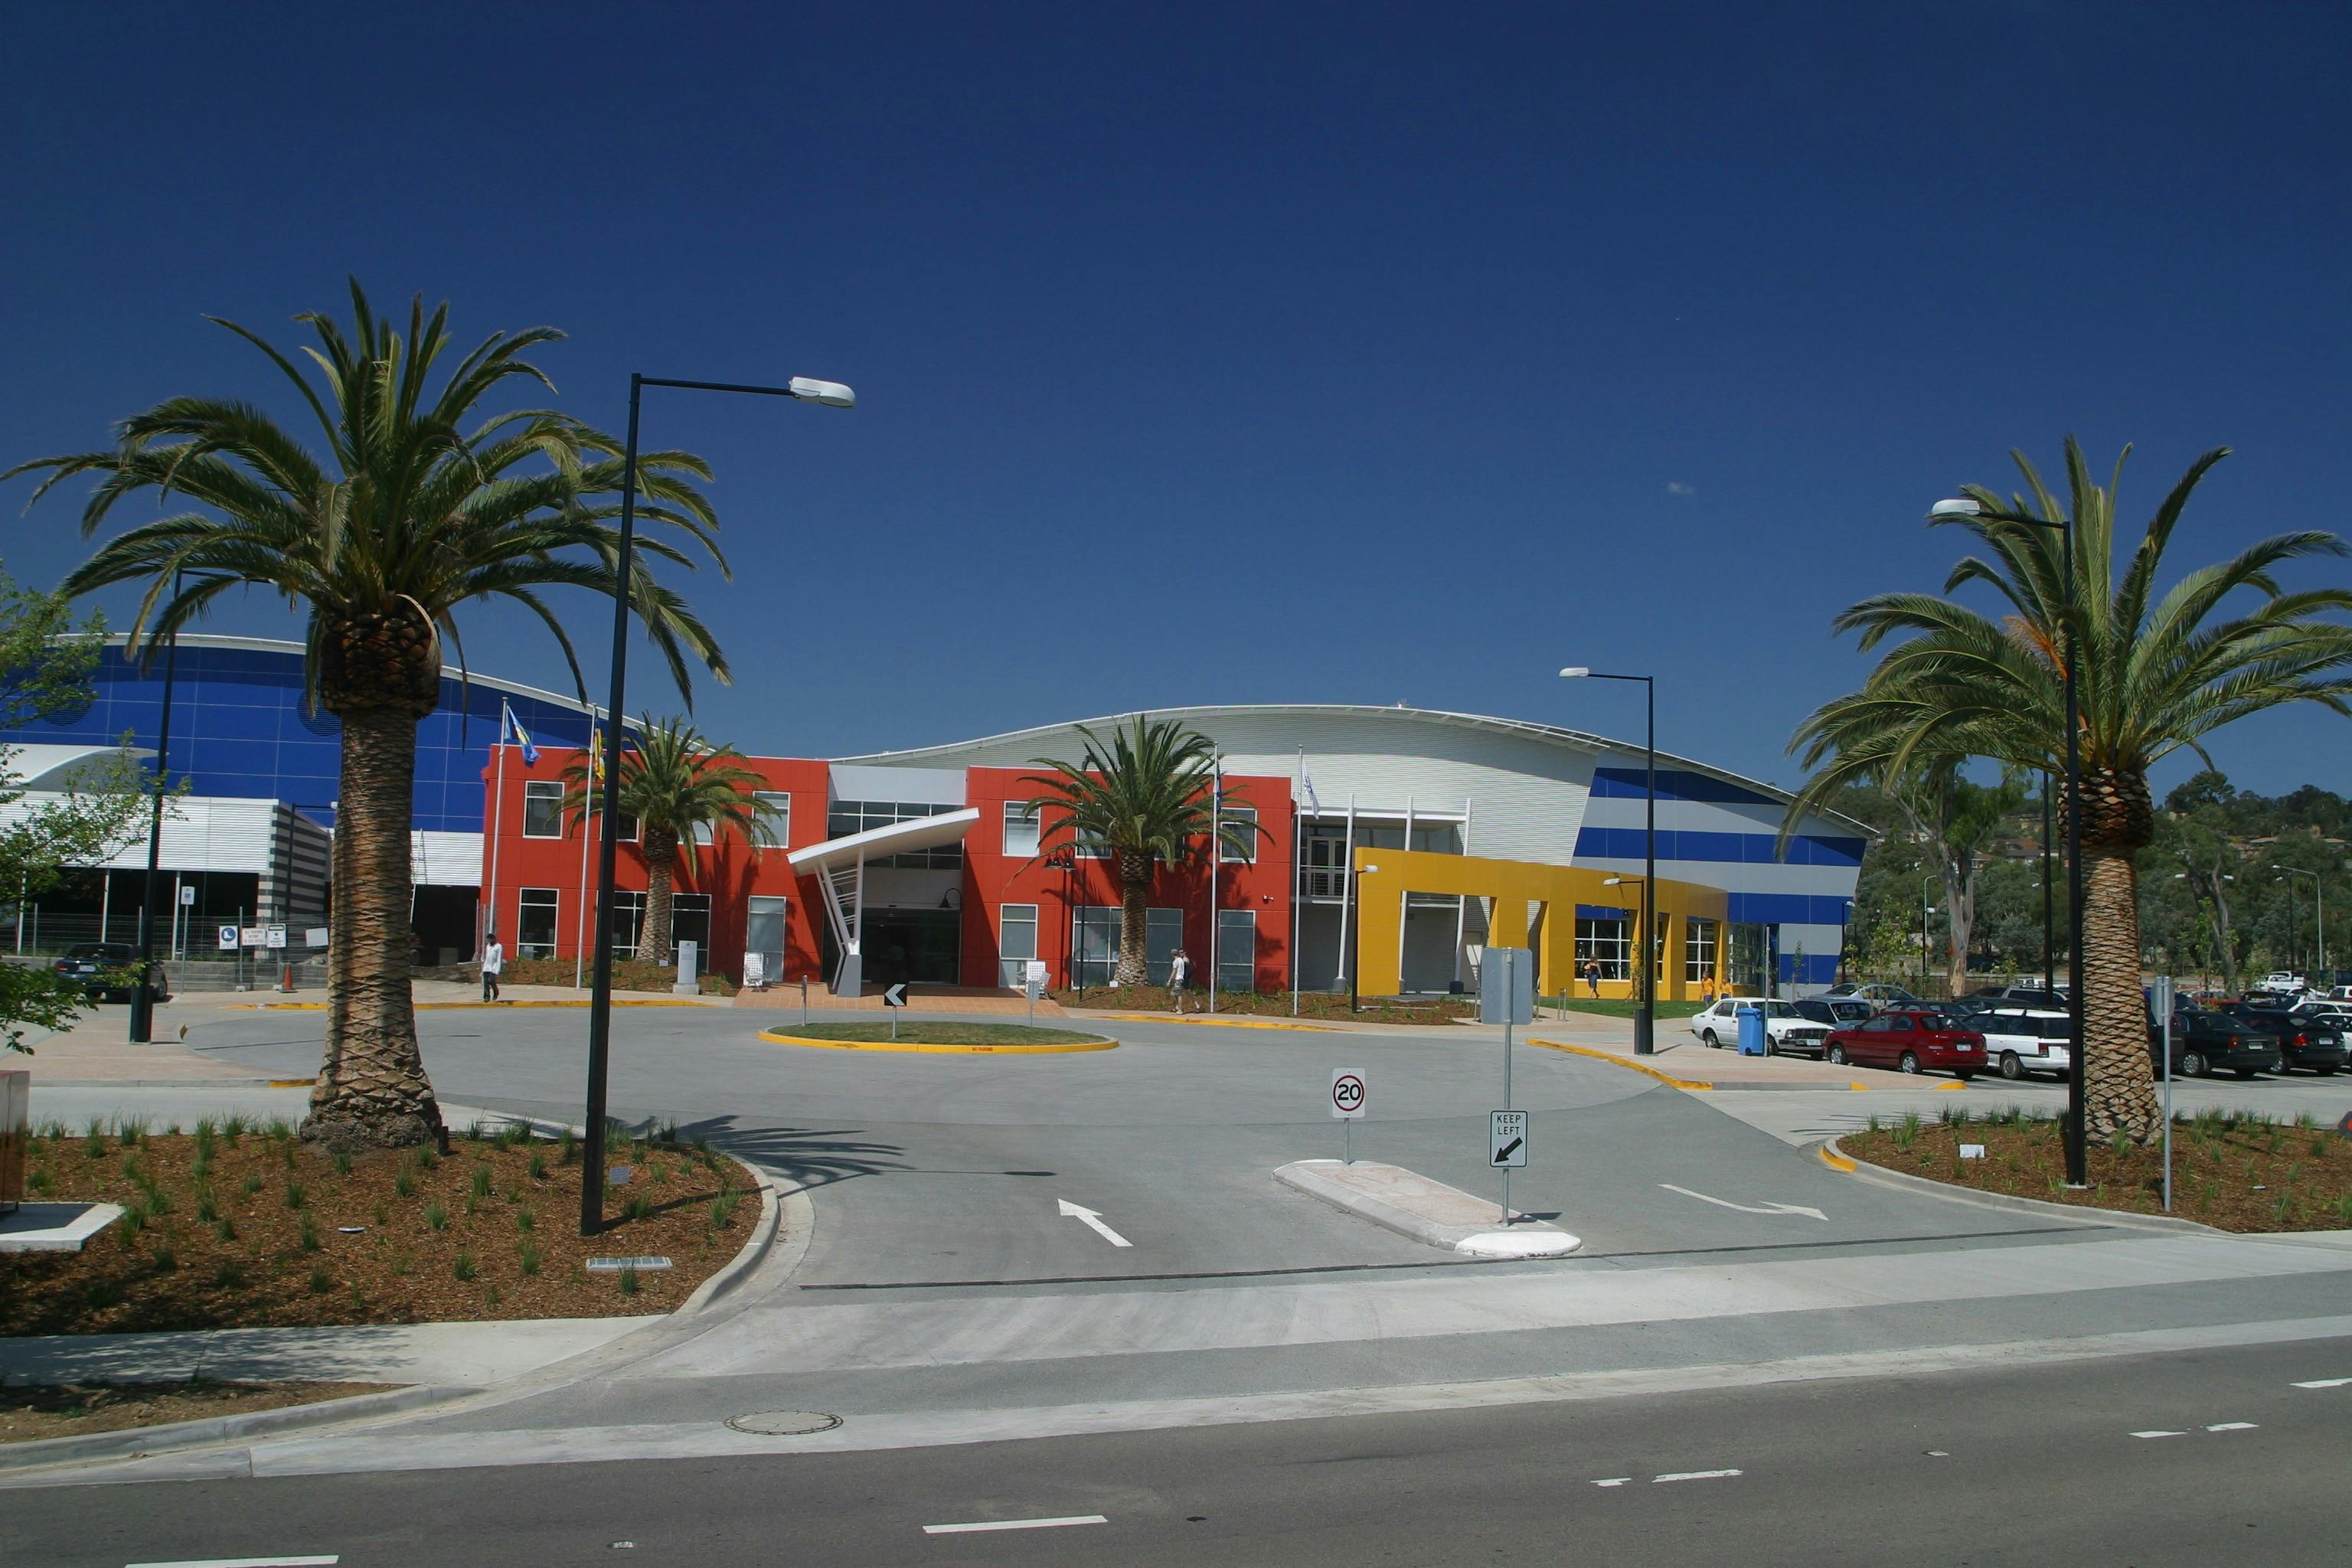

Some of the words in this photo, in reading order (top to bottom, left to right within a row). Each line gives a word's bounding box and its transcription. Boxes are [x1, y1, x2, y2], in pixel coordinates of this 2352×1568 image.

[1338, 1083, 1361, 1101] 20
[1497, 1114, 1521, 1124] KEEP
[1498, 1126, 1520, 1135] LEFT
